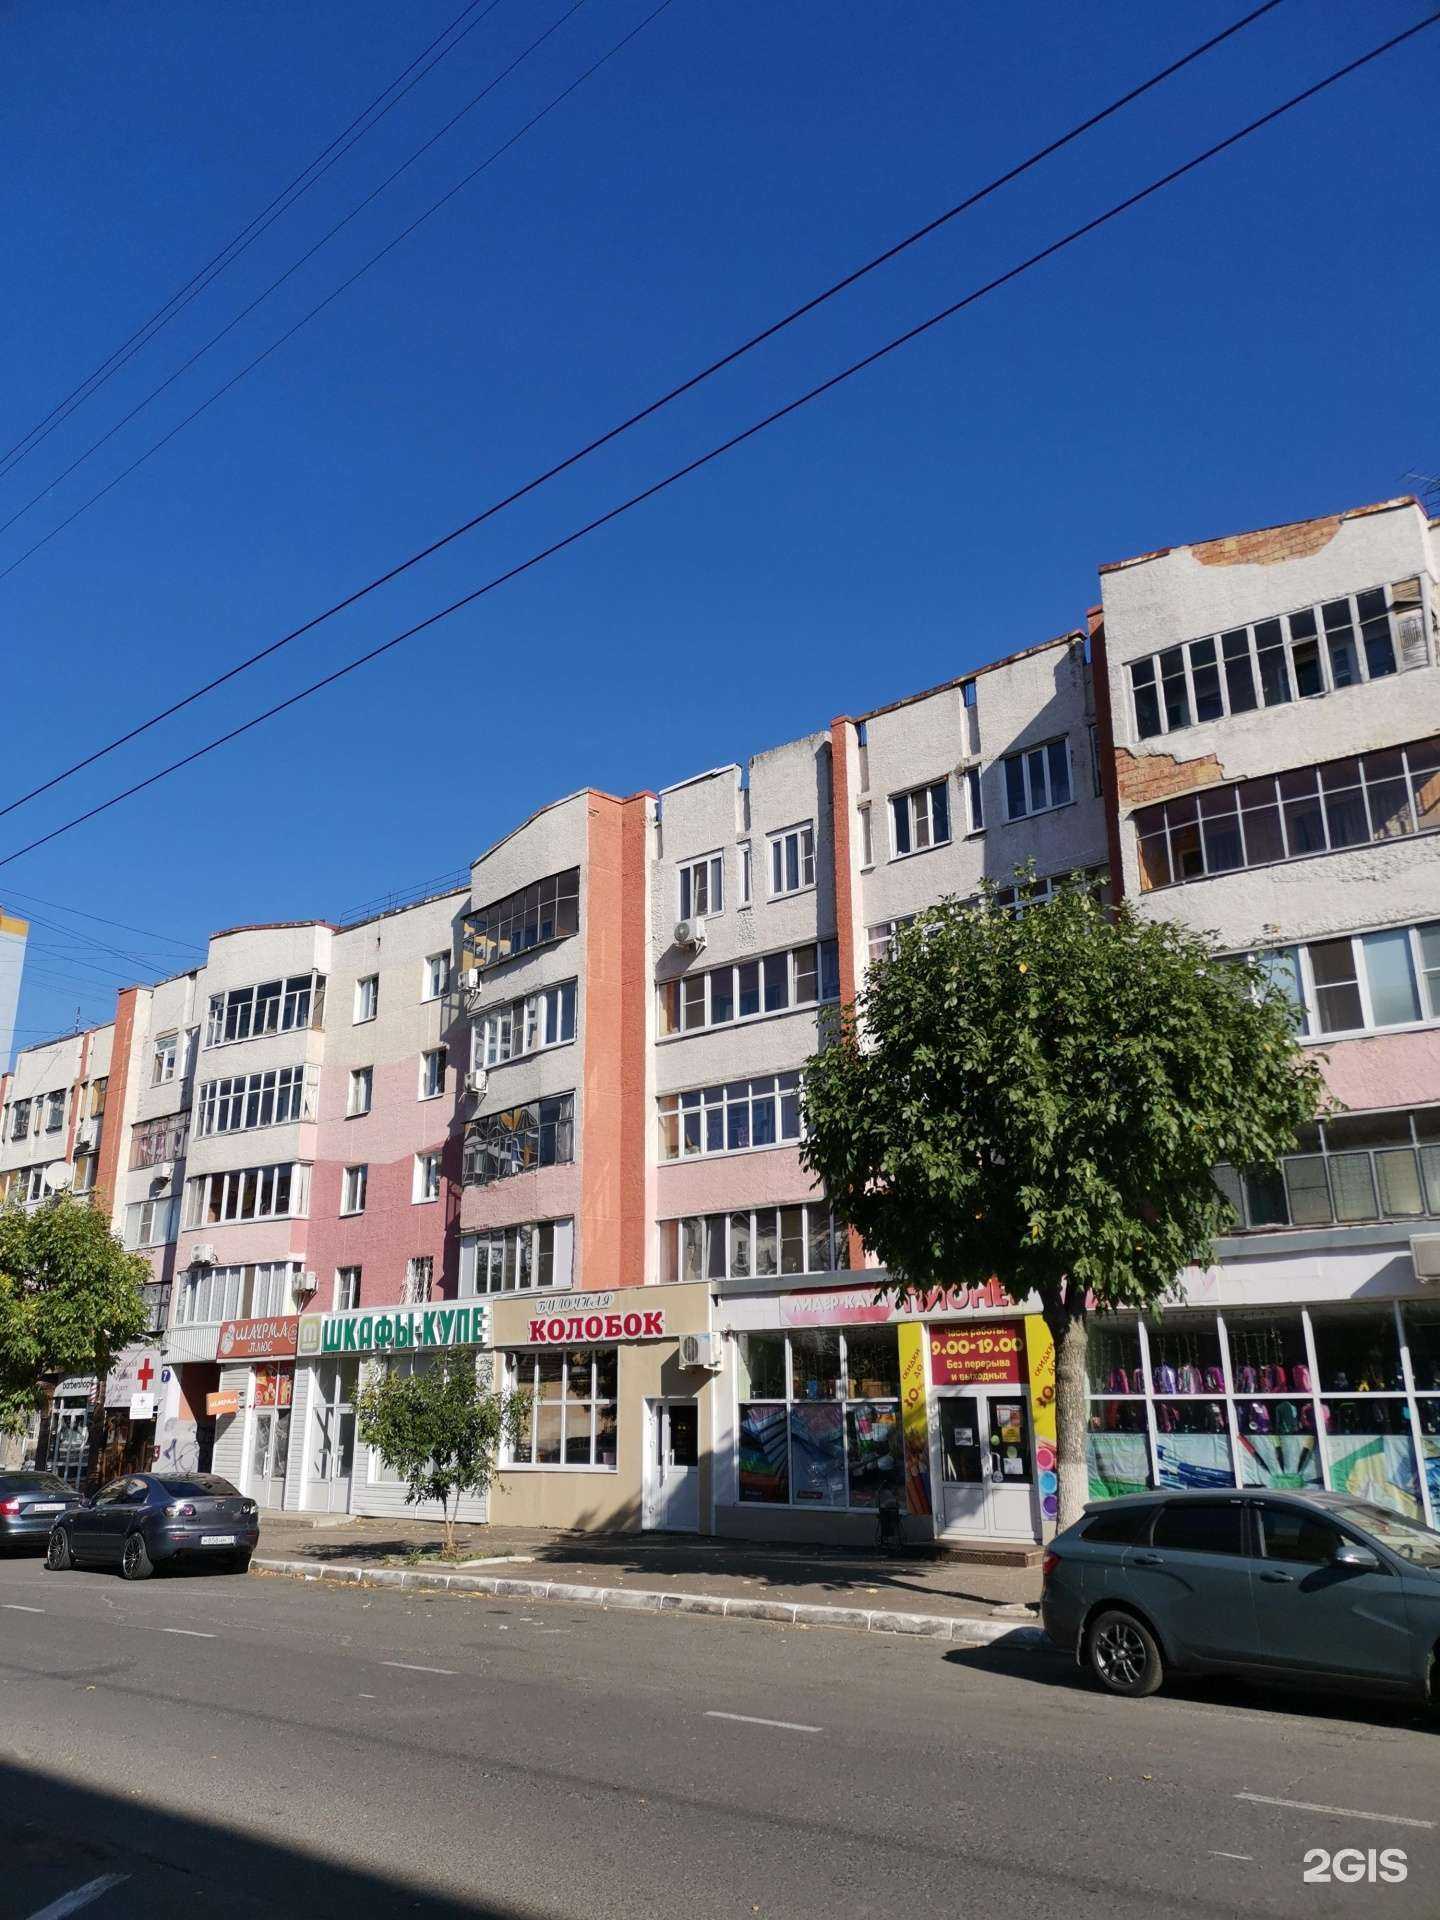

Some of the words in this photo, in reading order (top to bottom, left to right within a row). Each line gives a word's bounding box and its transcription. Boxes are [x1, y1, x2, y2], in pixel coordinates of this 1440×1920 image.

[322, 1308, 483, 1351] ШКАФЫ-КУПЕ
[529, 1311, 663, 1342] КОЛОБОК
[931, 1337, 1023, 1355] 9.00-19.00
[946, 1360, 962, 1369] Без
[965, 1358, 1010, 1370] перерыва
[959, 1371, 1008, 1382] выходных
[62, 1380, 91, 1391] barbershop
